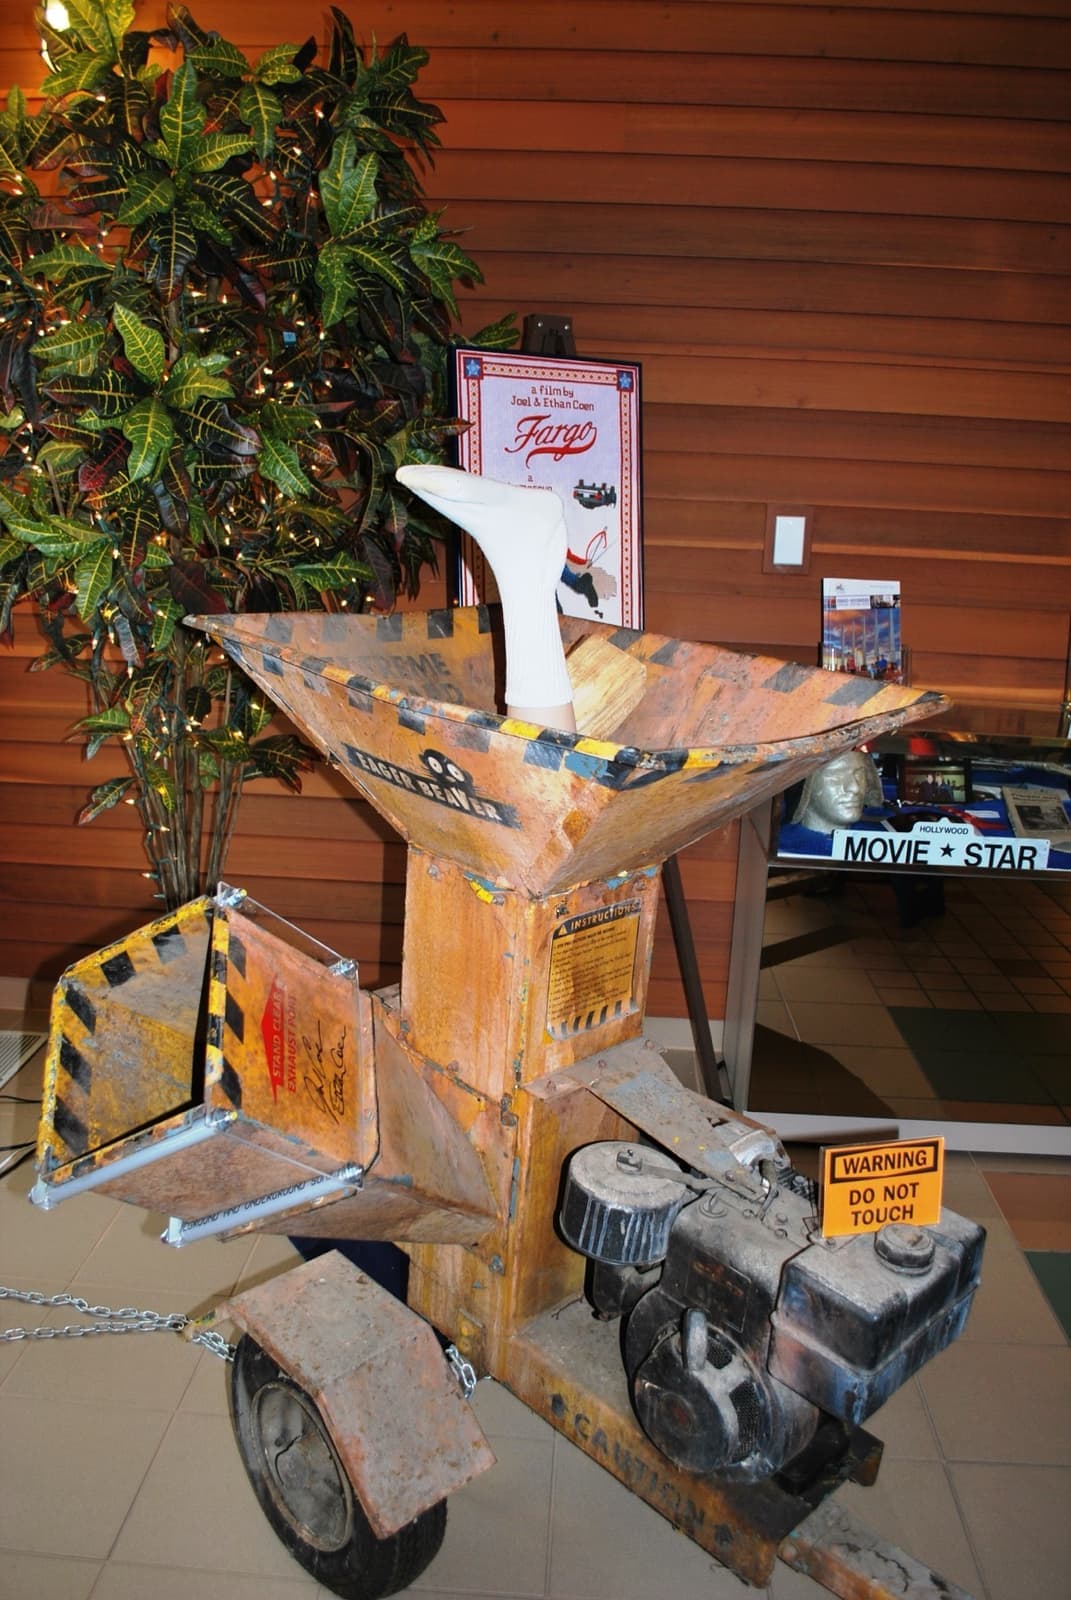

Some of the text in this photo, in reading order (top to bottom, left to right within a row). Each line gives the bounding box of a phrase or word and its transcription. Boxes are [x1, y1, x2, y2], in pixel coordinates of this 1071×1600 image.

[511, 395, 595, 411] Joel & Ethan Coen
[531, 385, 574, 398] a film by
[505, 414, 597, 469] Fargo
[355, 751, 503, 822] EAGER BEAVER
[919, 825, 969, 835] HOLLYWOOD
[844, 836, 1038, 870] MOVIE STAR
[571, 902, 637, 931] INSTRUCTIONS
[272, 1034, 281, 1077] STAND
[287, 1030, 297, 1093] EXHAUST
[843, 1151, 926, 1174] WARNING
[849, 1182, 920, 1206] DO NOT
[851, 1204, 914, 1226] TOUCH
